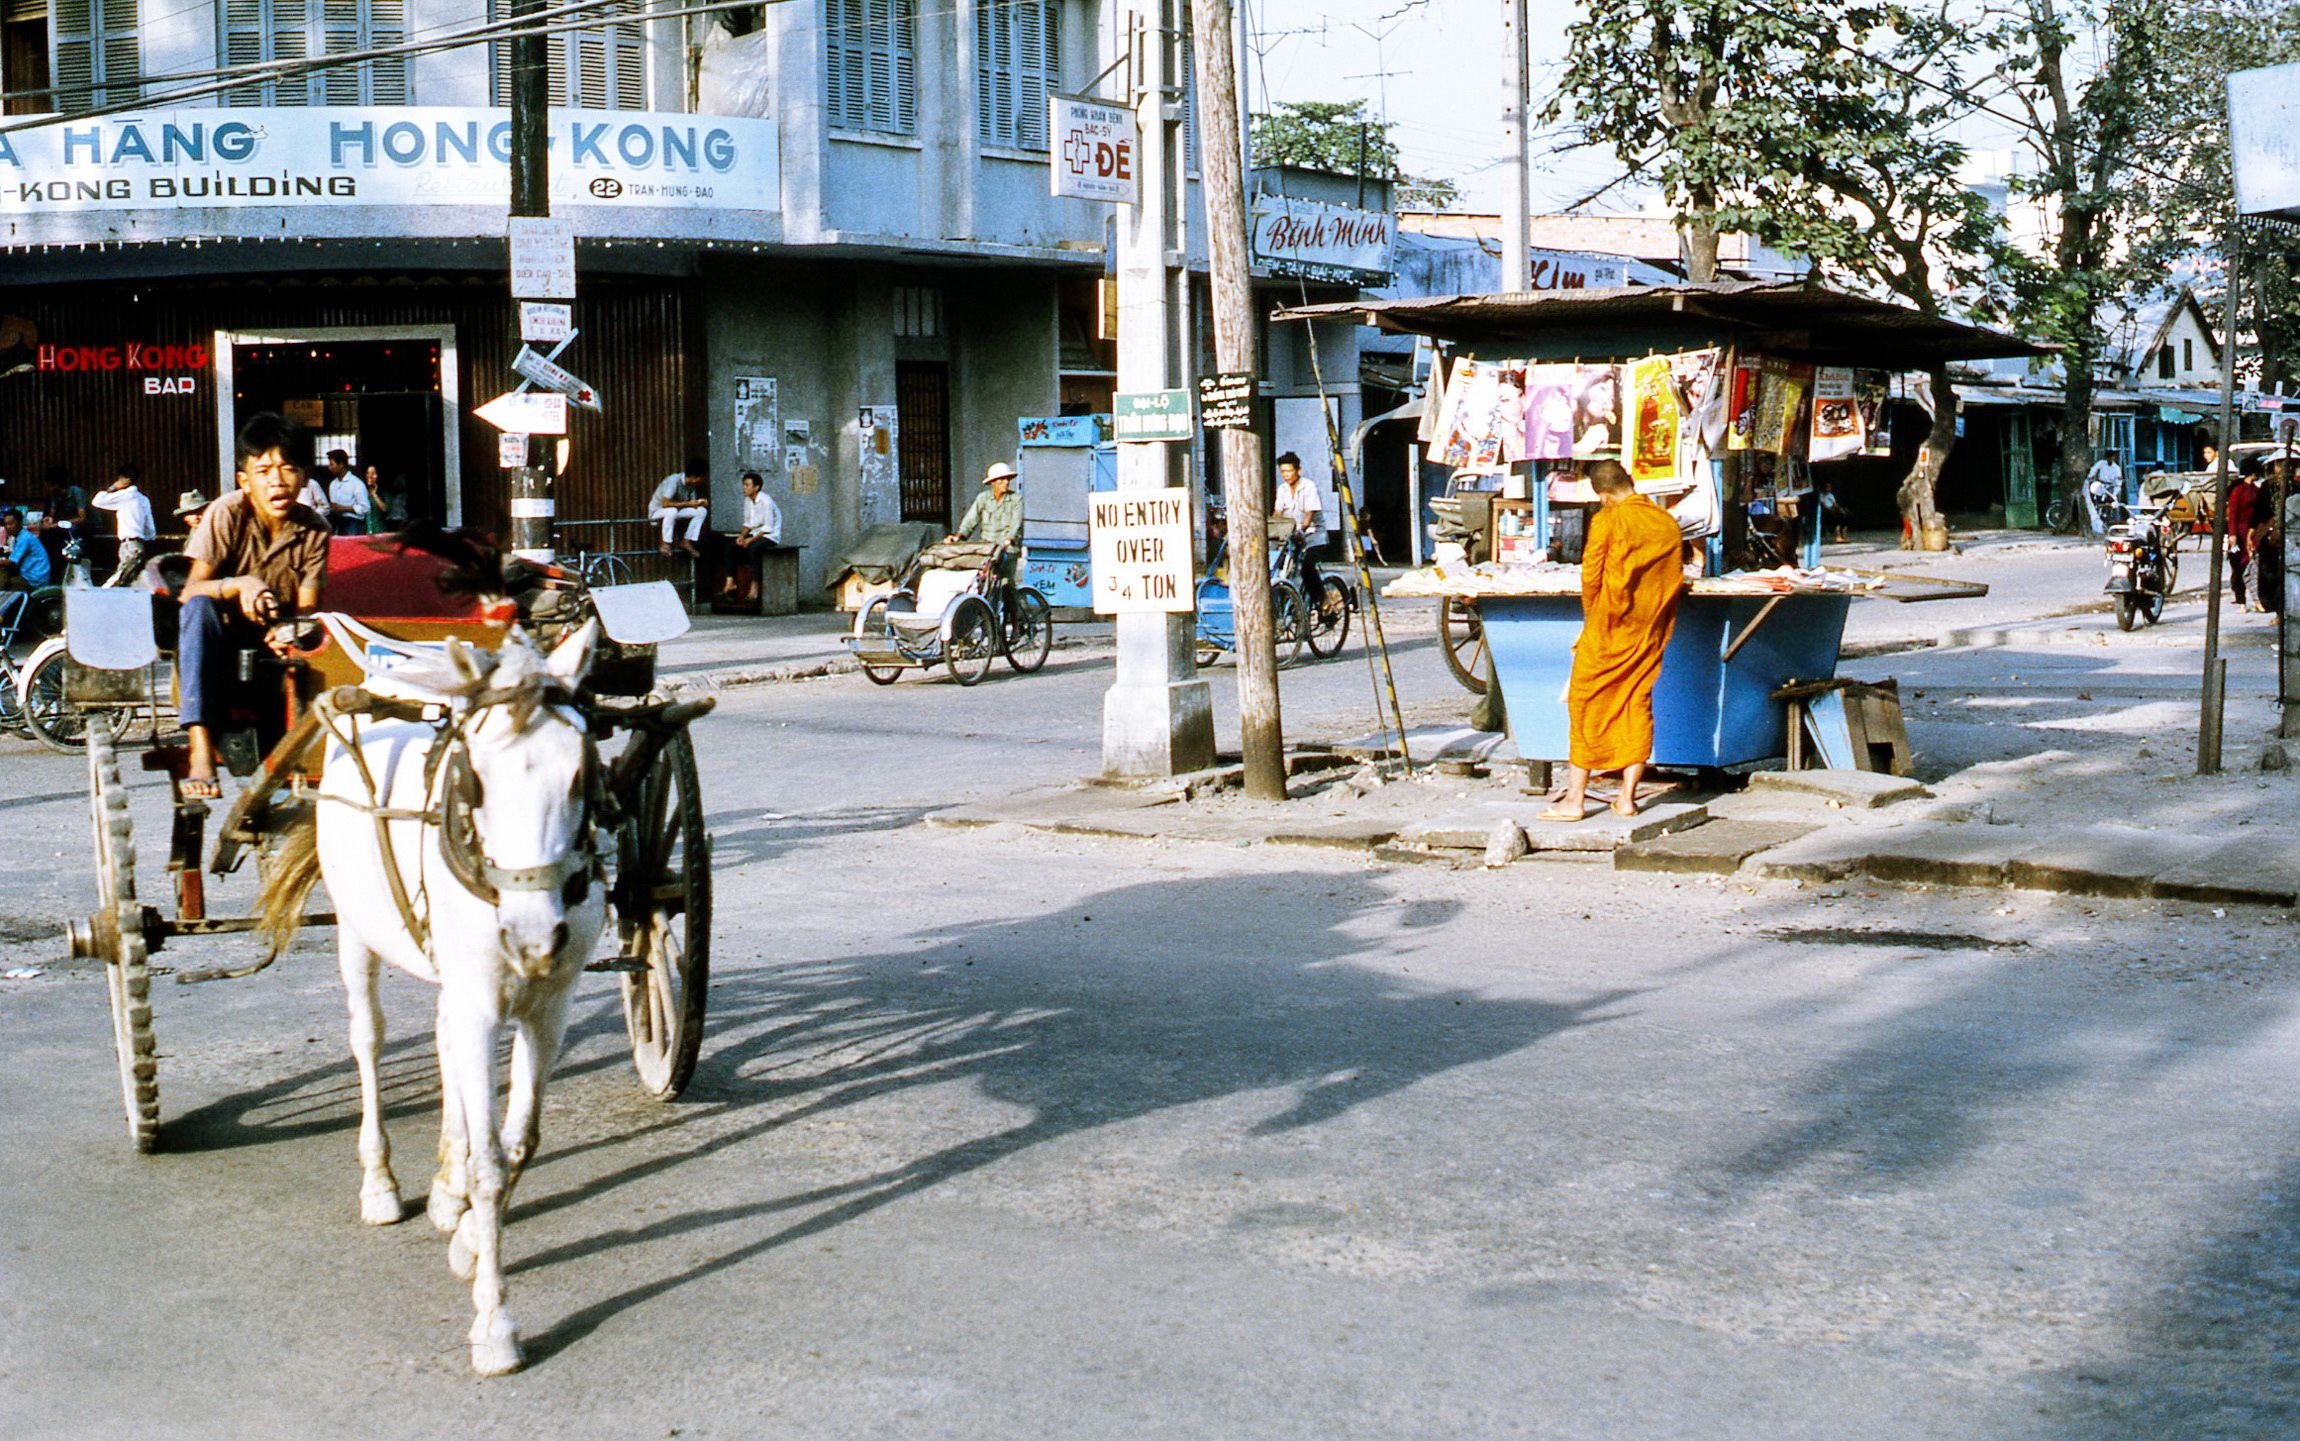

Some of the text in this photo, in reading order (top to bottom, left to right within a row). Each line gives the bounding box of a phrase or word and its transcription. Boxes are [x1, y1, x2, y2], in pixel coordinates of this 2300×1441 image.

[330, 121, 511, 163] HONG
[572, 122, 735, 170] KONG
[592, 179, 619, 197] 22
[1328, 214, 1387, 248] Minh
[38, 343, 209, 371] HONG KONG
[1096, 500, 1180, 529] NO ENTRY
[1117, 538, 1163, 564] OVER
[1142, 573, 1176, 600] TON
